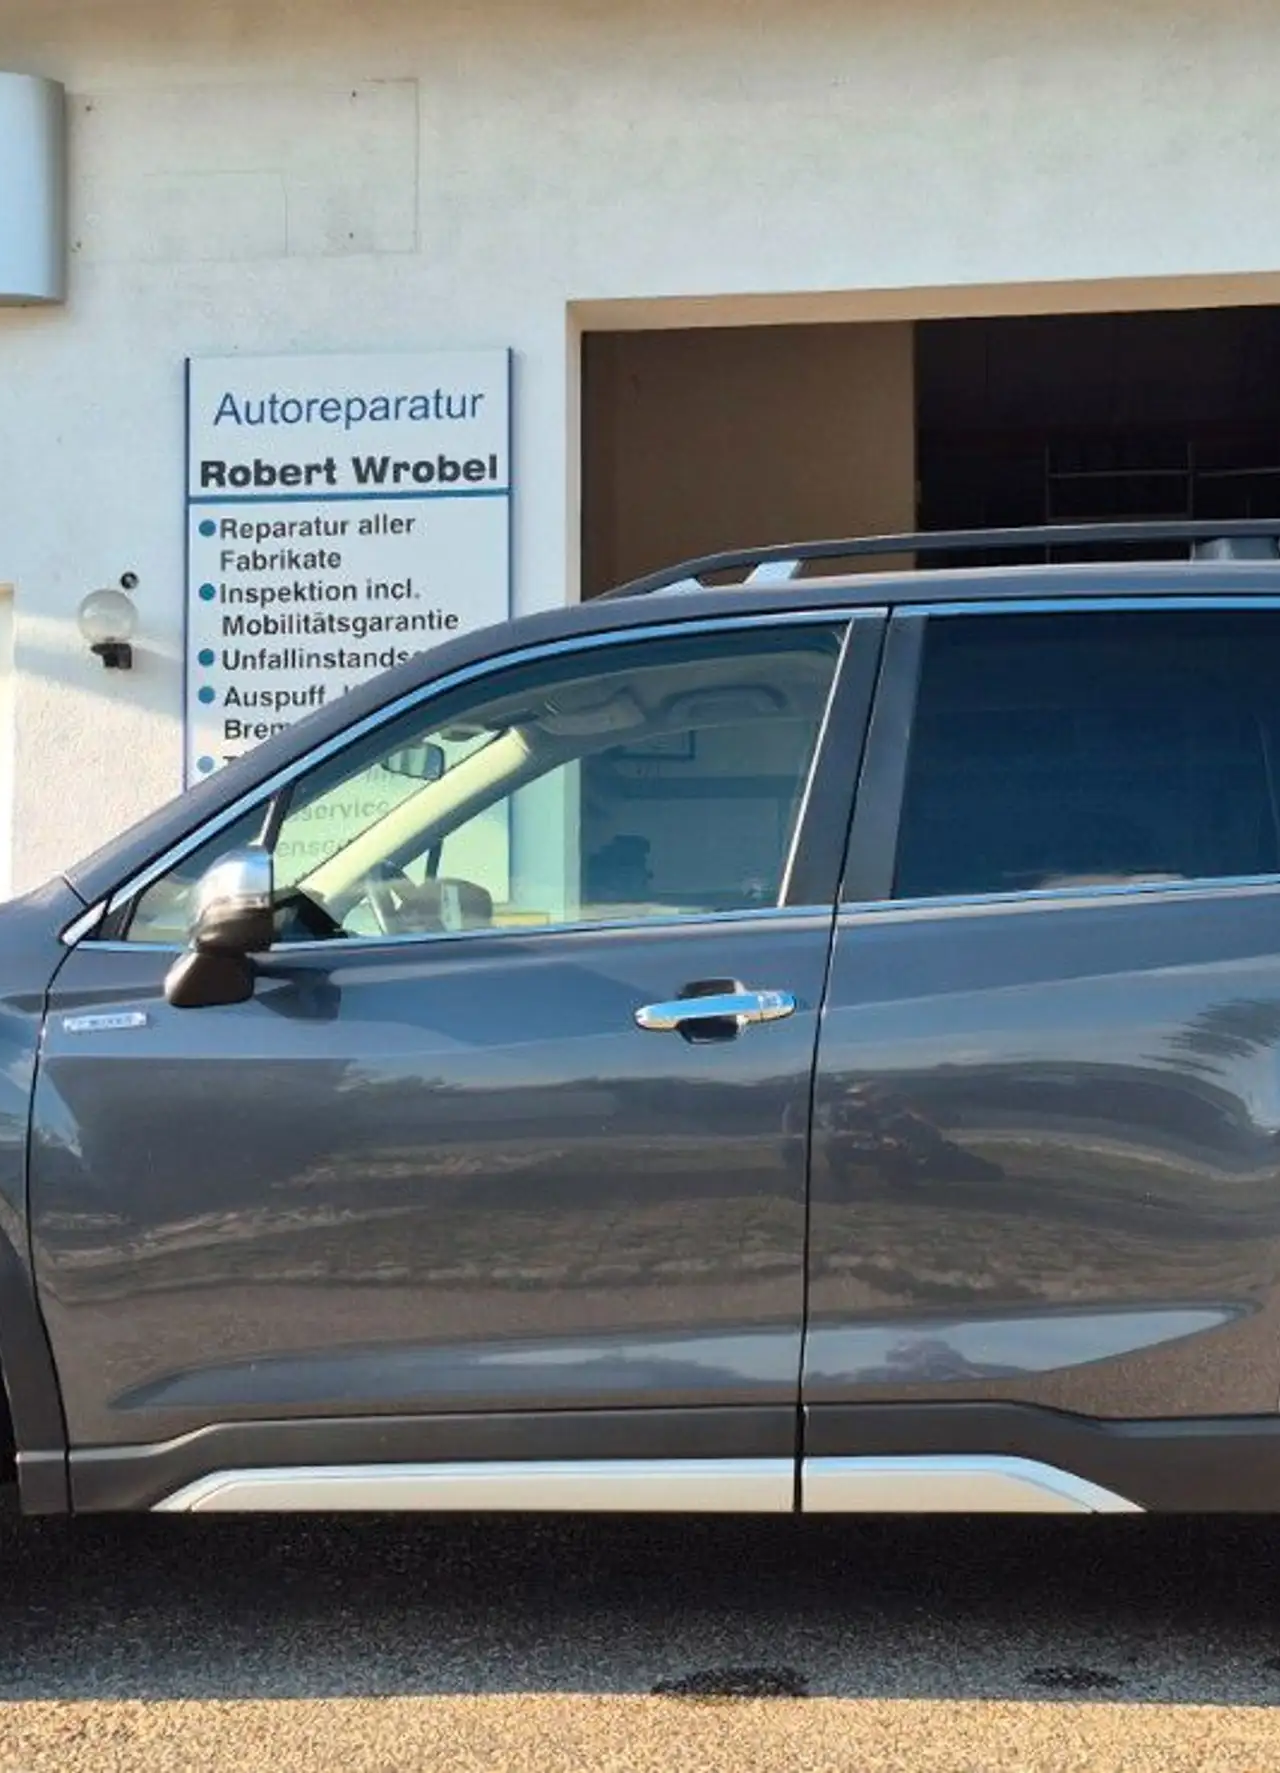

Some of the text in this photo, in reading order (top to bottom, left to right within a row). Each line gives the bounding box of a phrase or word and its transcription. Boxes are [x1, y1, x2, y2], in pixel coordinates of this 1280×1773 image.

[213, 388, 485, 431] Autoreparatur
[200, 454, 497, 488] Robert Wrobel
[220, 513, 416, 543] Reparatur aller
[220, 549, 342, 572] Fabrikate
[220, 578, 421, 608] Inspektion incl.
[222, 608, 460, 638] Mobilitätsgarantie
[222, 648, 420, 671] Unfallinstands
[223, 684, 326, 712] Auspuff
